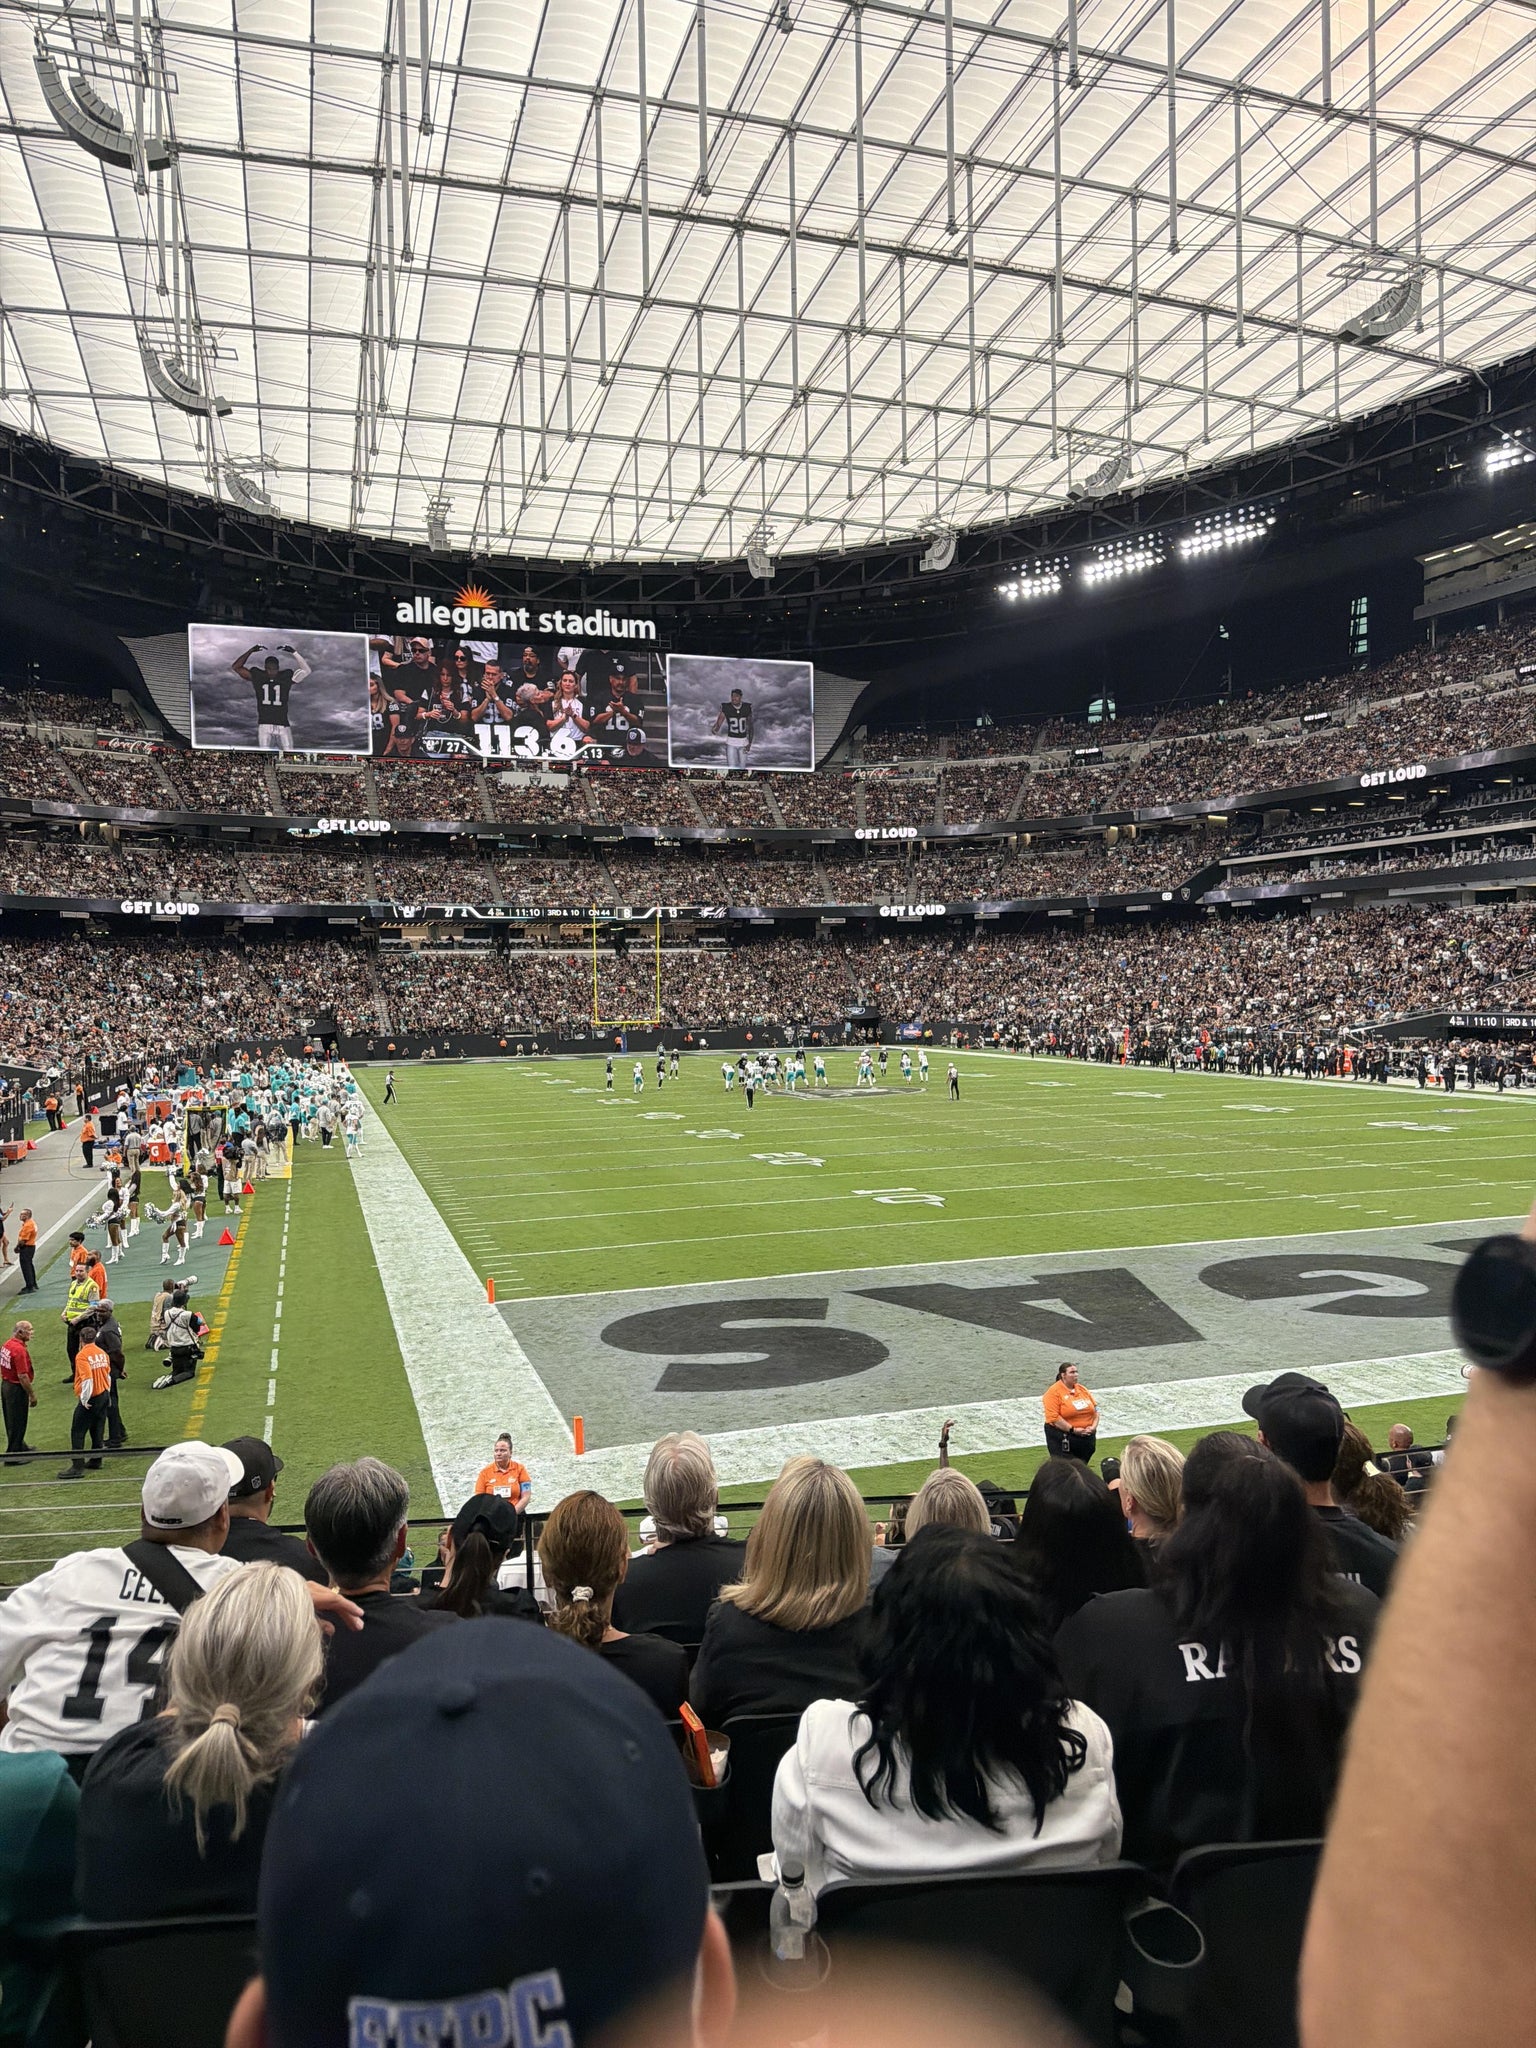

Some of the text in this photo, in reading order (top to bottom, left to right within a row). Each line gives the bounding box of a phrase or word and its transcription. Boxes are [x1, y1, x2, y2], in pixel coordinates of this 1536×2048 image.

[396, 597, 656, 639] allegiant stadium
[262, 683, 283, 706] 11
[728, 717, 747, 734] 20
[474, 724, 577, 758] 113.6
[446, 742, 460, 753] 27
[591, 748, 603, 759] 13
[1360, 764, 1427, 787] GET LOUD
[317, 818, 391, 832] GET LOUD
[855, 827, 918, 839] GET LOUD
[120, 900, 200, 916] GET LOUD
[515, 908, 541, 917] 11:10
[547, 909, 561, 917] 3RD
[570, 909, 579, 917] 10
[588, 909, 611, 917] ON 44
[879, 904, 946, 917] GET LOUD
[1449, 1015, 1456, 1027] 4
[1474, 1016, 1497, 1027] 11:10
[1505, 1016, 1521, 1026] 3RD
[1522, 1016, 1528, 1026] &
[151, 1145, 159, 1157] G
[851, 1187, 946, 1205] 10
